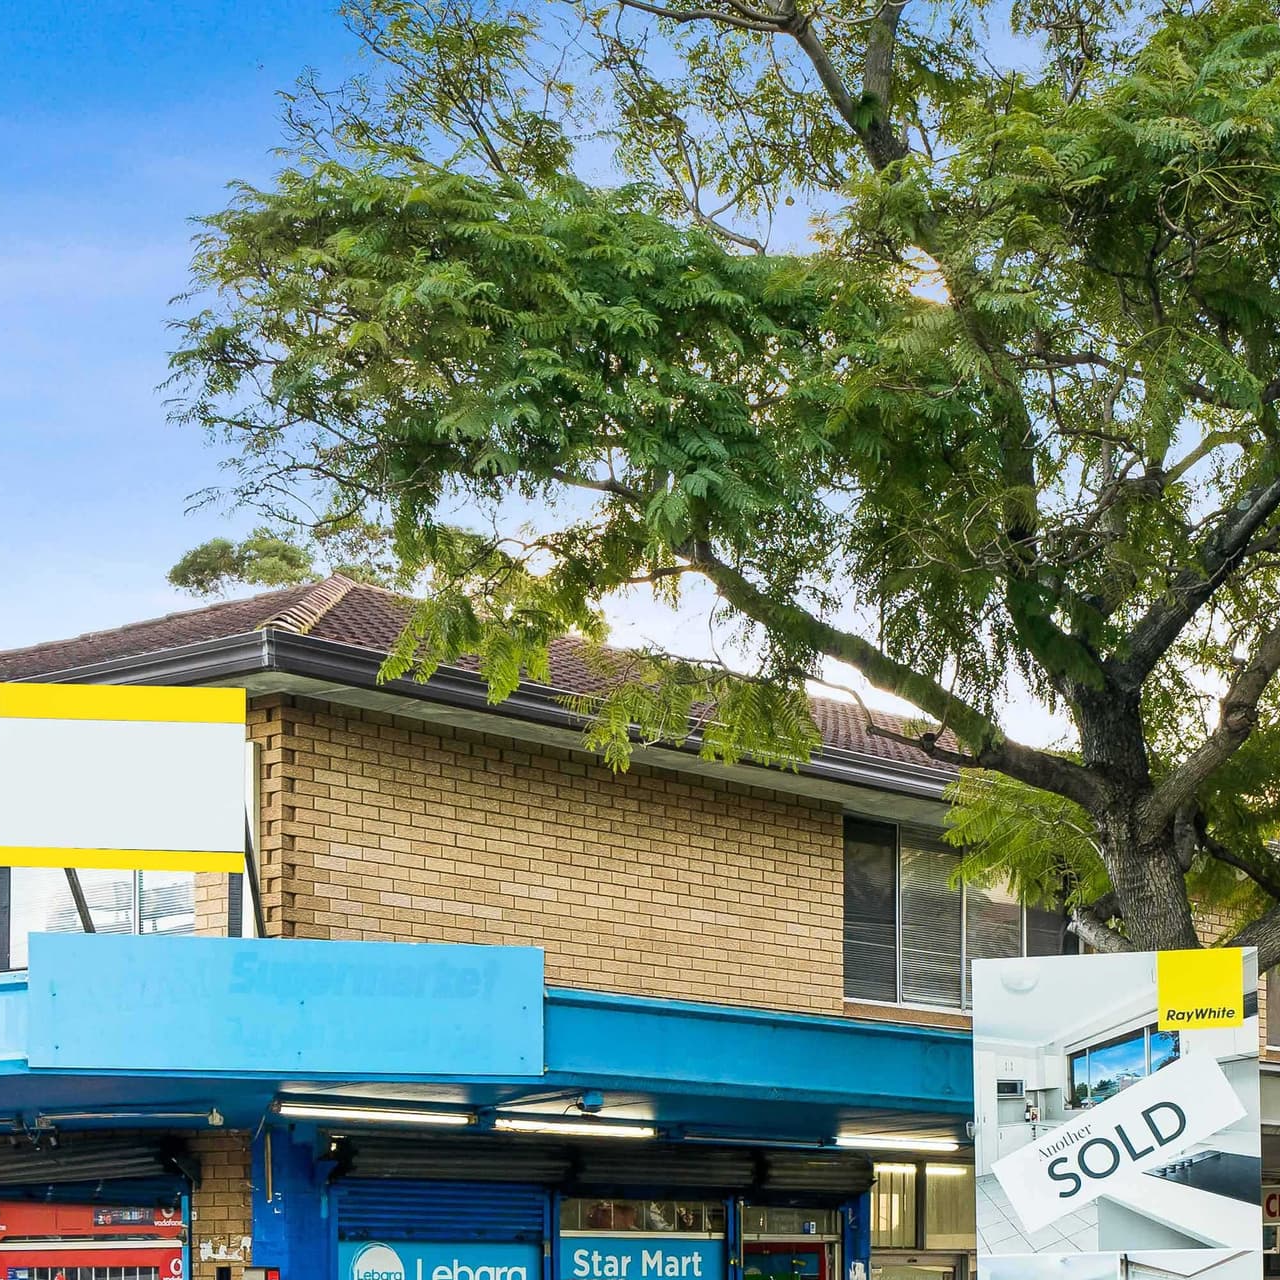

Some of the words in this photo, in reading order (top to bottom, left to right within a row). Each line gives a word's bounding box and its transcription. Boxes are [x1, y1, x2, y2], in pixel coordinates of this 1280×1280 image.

[1166, 1007, 1235, 1022] RayWhite
[1039, 1123, 1092, 1162] Another
[1047, 1101, 1186, 1198] SOLD
[357, 1269, 402, 1280] Lebara
[573, 1249, 631, 1277] Star
[642, 1250, 702, 1277] Mart
